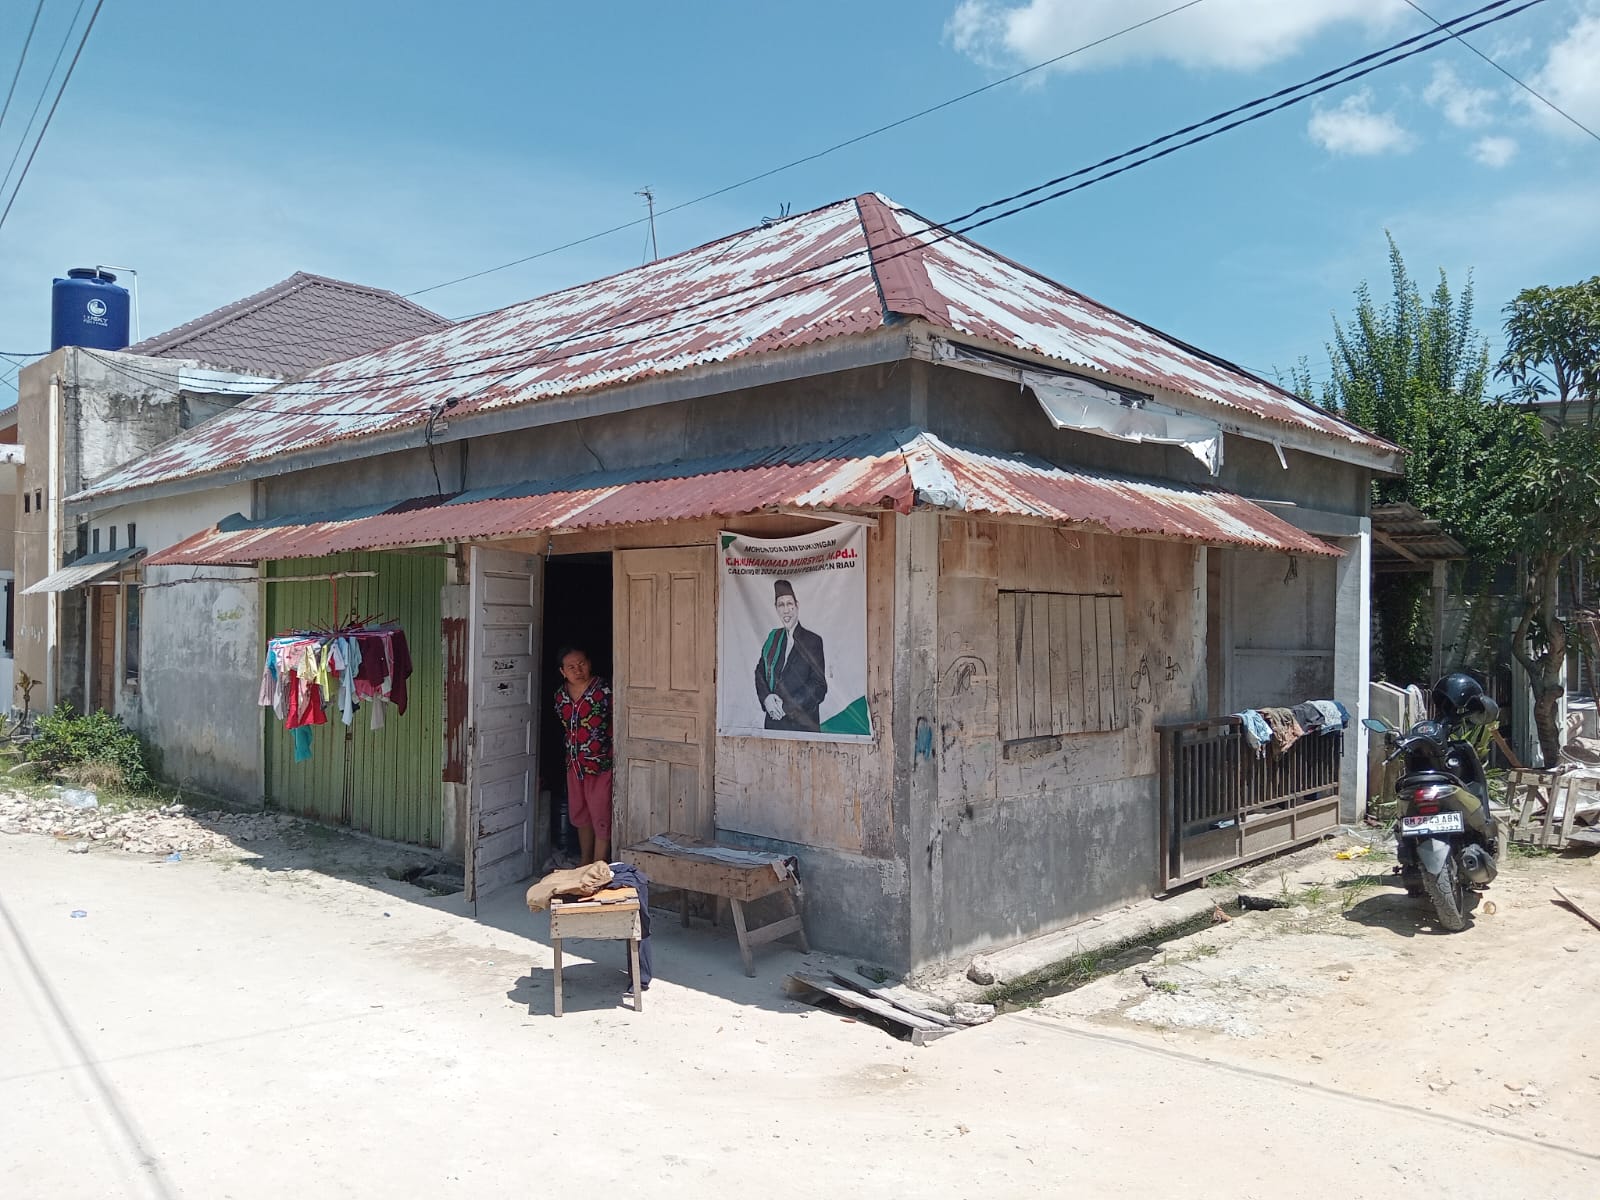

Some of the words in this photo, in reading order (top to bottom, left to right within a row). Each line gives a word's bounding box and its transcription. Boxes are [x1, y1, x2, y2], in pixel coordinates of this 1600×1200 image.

[798, 539, 837, 551] DUKUNGAN
[836, 561, 856, 570] RIAU
[1404, 817, 1416, 826] BM
[1442, 814, 1460, 823] ABN
